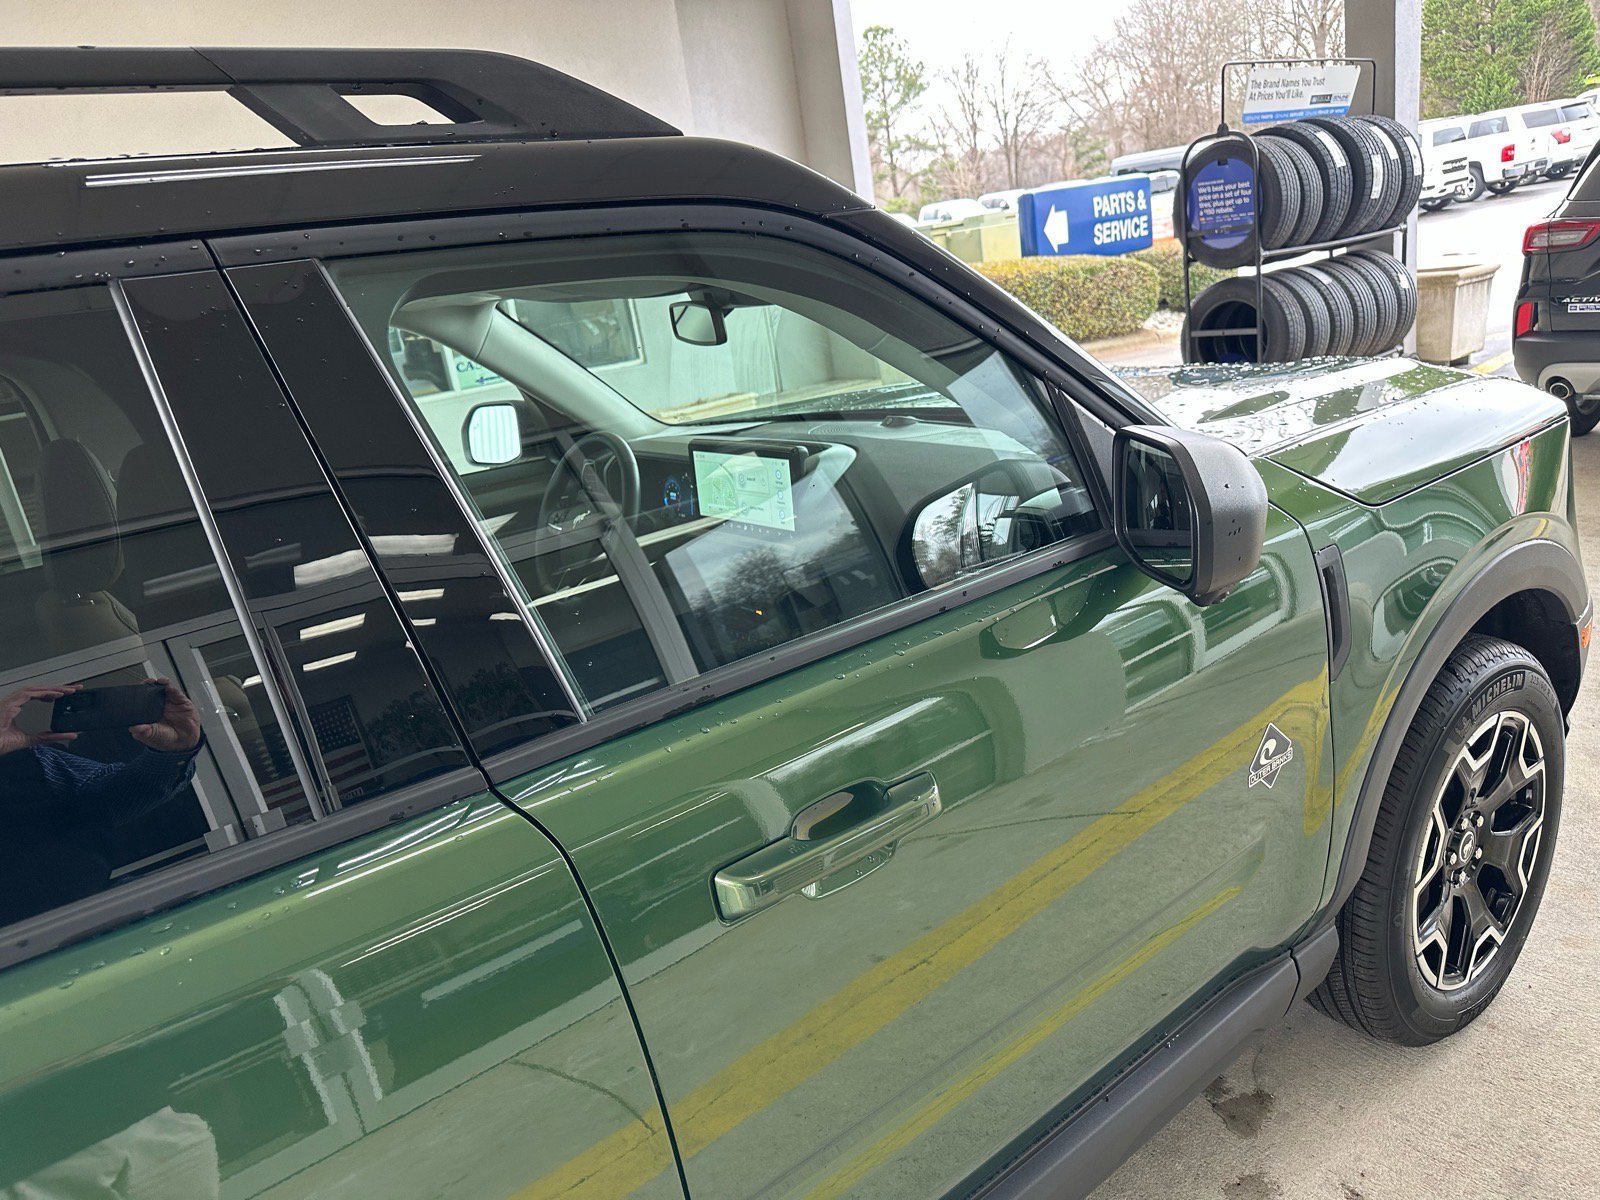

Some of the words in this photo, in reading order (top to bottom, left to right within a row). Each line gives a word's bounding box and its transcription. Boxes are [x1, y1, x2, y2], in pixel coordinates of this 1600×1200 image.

[1248, 91, 1256, 101] At
[1257, 90, 1273, 100] Prices
[1276, 89, 1290, 100] You'll
[1251, 79, 1261, 89] The
[1263, 78, 1280, 89] Brand
[1281, 77, 1300, 88] Names
[1302, 76, 1311, 87] You
[1313, 76, 1325, 86] Trust
[1093, 190, 1136, 218] PARTS
[1137, 189, 1147, 211] &
[1093, 215, 1149, 246] SERVICE
[1471, 672, 1525, 719] MICHELIN
[1250, 764, 1271, 784] OUTER
[1271, 750, 1292, 770] BANKS
